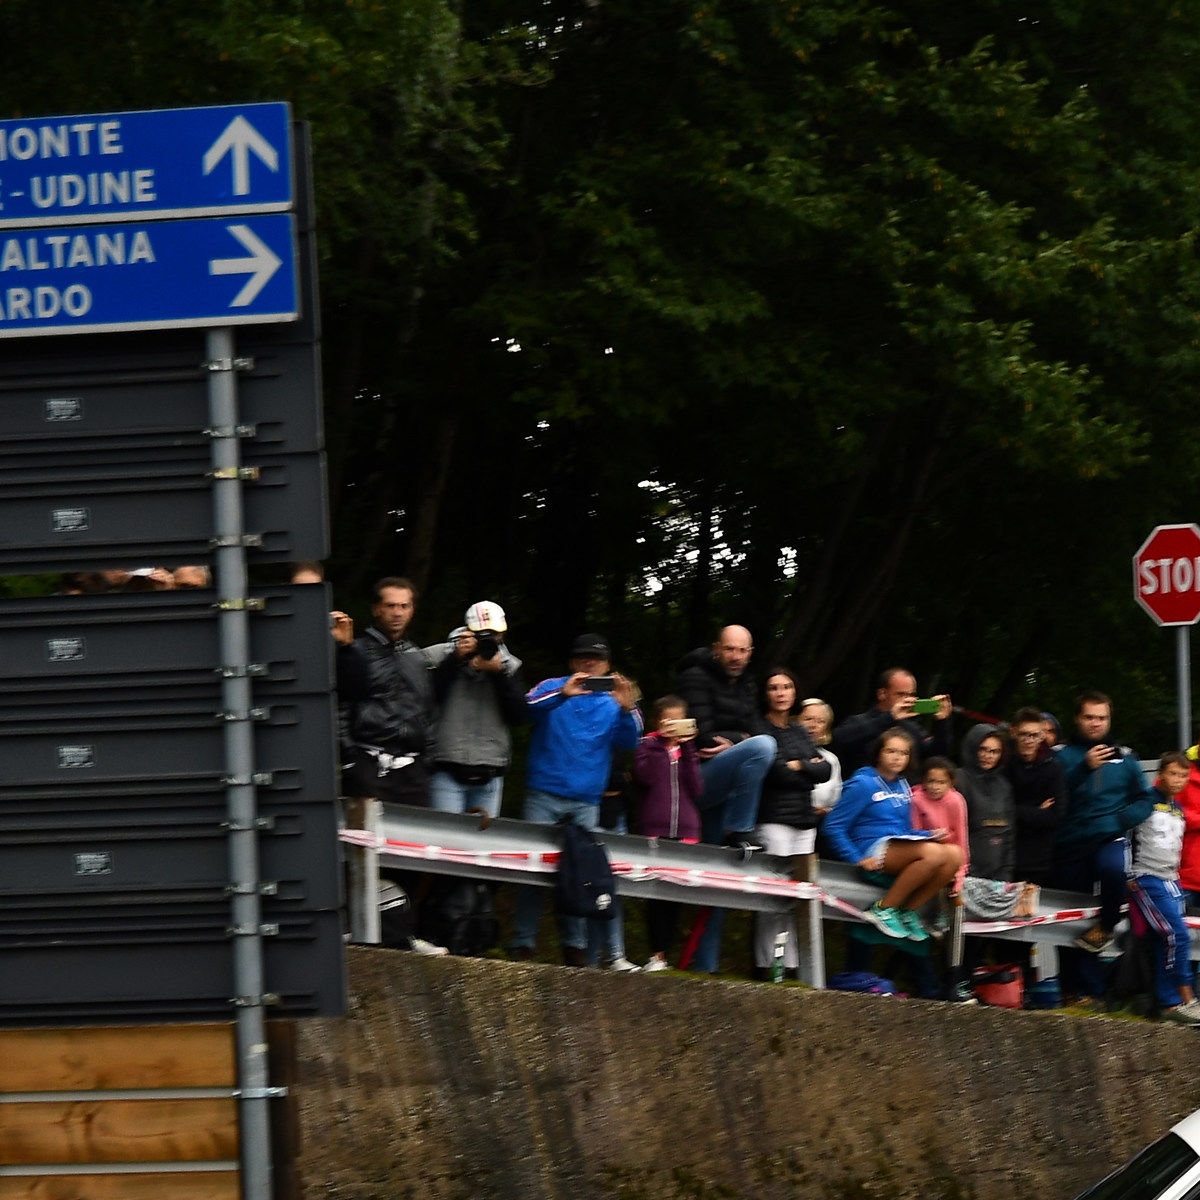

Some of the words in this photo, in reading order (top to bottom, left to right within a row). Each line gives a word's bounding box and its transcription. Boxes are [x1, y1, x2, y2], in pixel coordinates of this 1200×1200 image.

[0, 120, 124, 161] ONTE
[30, 168, 157, 209] UDINE
[0, 230, 156, 272] ALTANA
